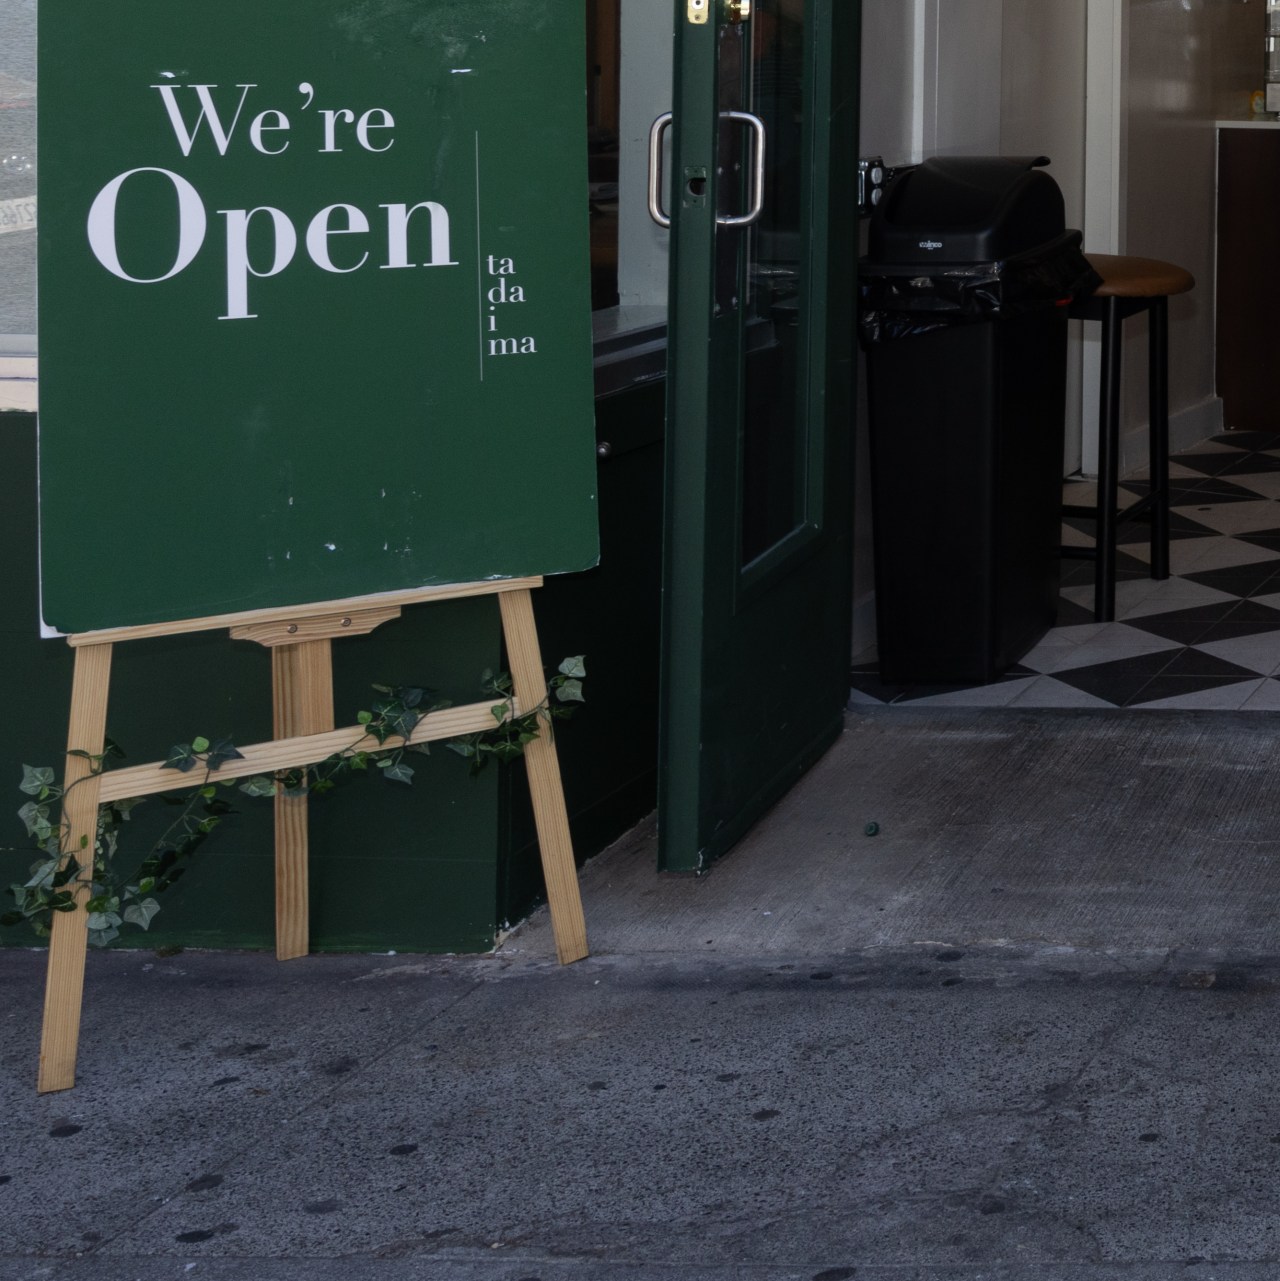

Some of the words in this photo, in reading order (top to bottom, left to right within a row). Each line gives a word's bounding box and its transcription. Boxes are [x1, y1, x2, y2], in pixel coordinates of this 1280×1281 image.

[149, 82, 395, 157] We’re
[87, 166, 459, 319] Open
[486, 254, 516, 275] ta
[487, 277, 527, 304] da
[488, 335, 538, 356] ma
